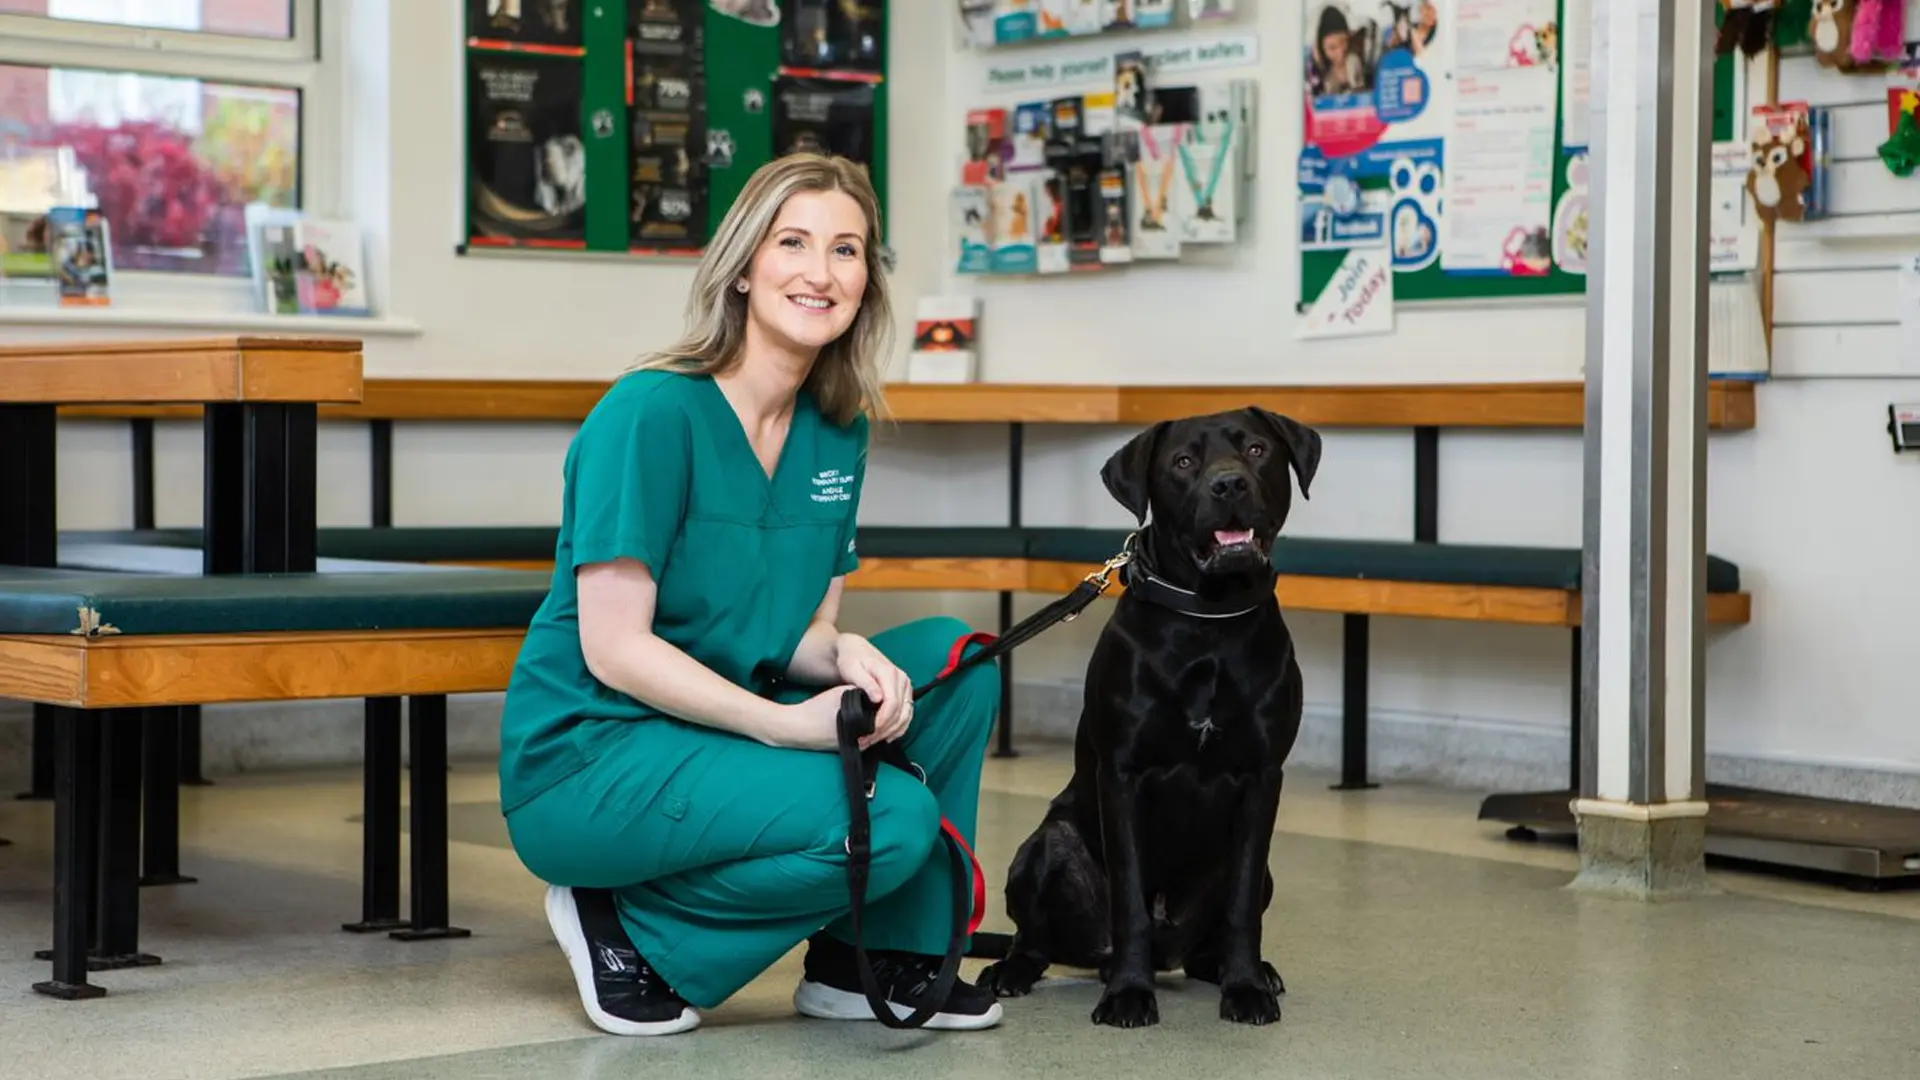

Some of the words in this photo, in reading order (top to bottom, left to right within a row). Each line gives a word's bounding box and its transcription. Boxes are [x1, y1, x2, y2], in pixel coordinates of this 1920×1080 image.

[989, 66, 1026, 82] Please
[1030, 64, 1054, 80] help
[1062, 56, 1110, 78] yourself
[1197, 41, 1246, 60] leaflets
[1338, 258, 1368, 303] Join
[1343, 265, 1387, 324] Today
